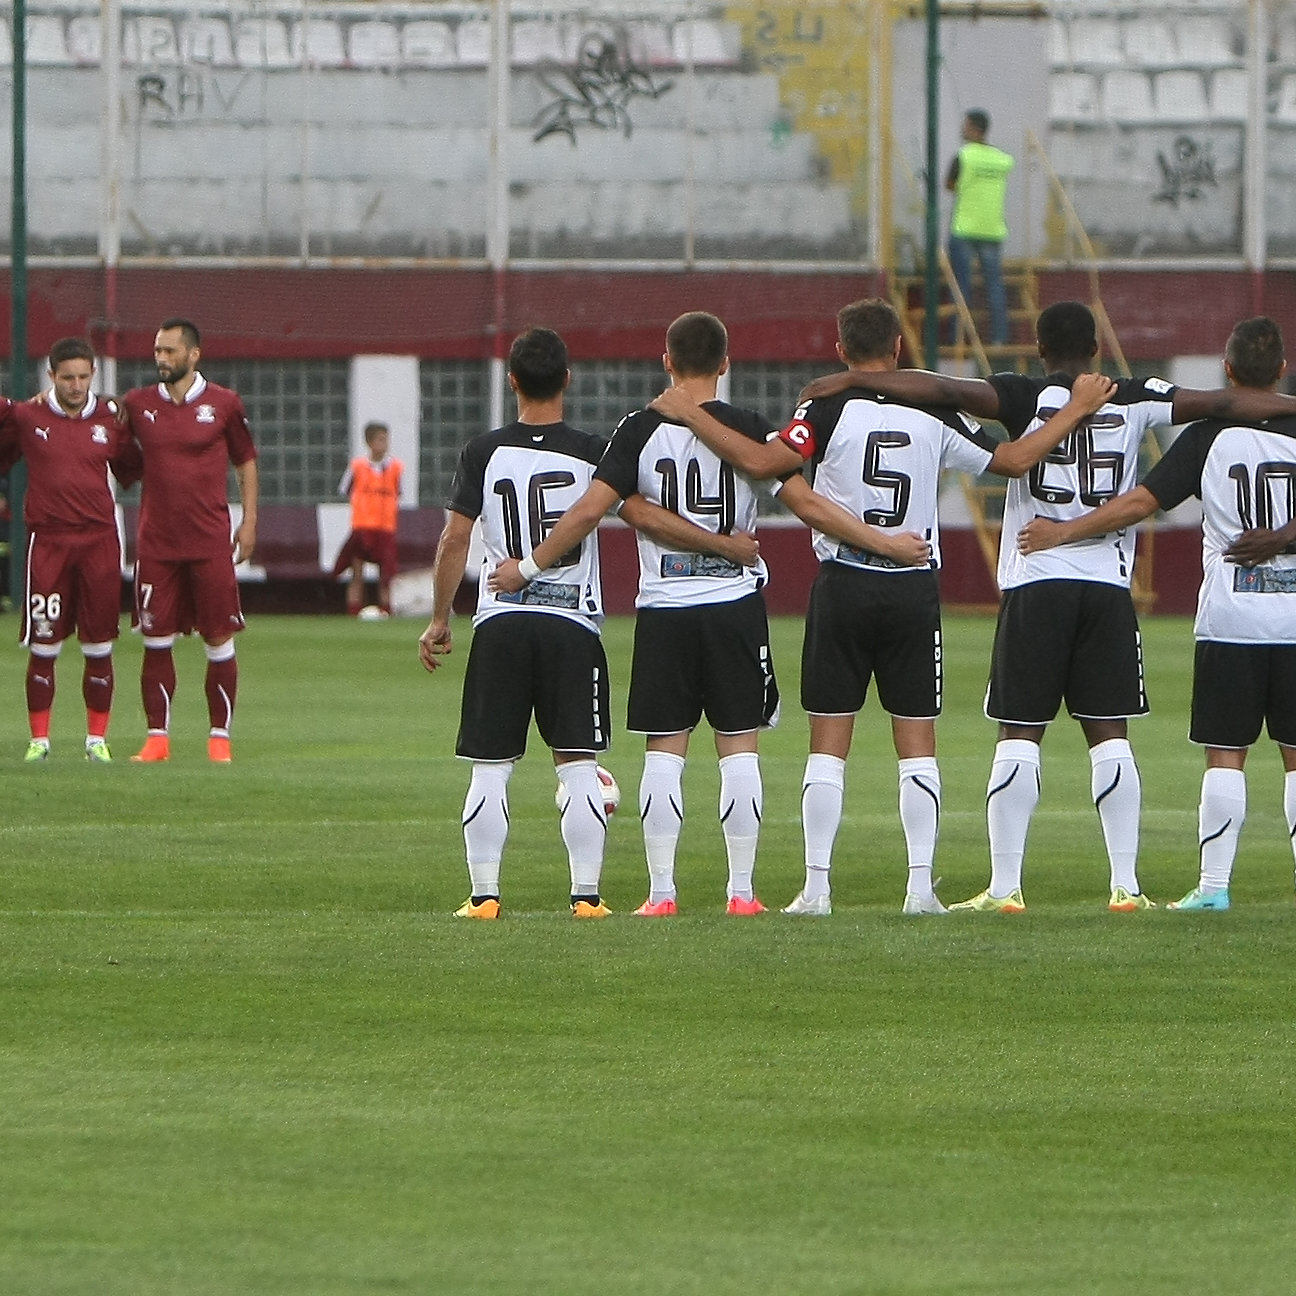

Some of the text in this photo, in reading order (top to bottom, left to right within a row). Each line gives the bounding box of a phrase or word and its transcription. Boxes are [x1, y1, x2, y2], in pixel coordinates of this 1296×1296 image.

[654, 458, 736, 537] 14
[862, 431, 912, 527] 5
[1029, 407, 1125, 507] 26
[493, 470, 582, 569] 16
[31, 592, 62, 621] 26
[140, 582, 154, 610] 7
